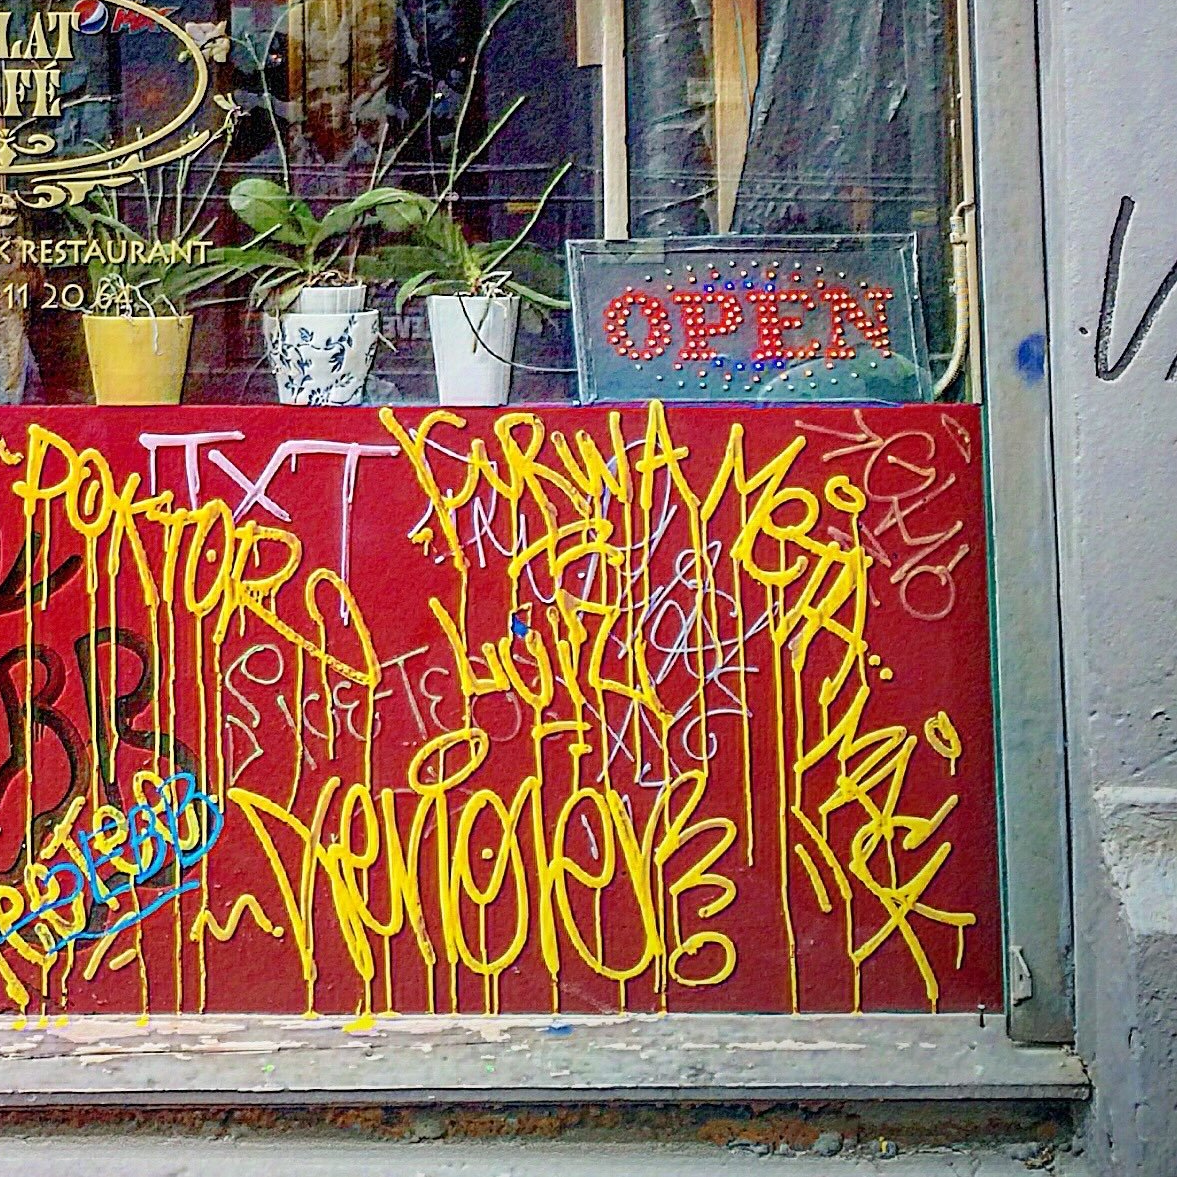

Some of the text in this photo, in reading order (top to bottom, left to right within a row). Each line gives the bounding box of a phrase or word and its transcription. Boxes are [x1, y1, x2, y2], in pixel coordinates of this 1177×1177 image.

[22, 239, 214, 266] RESTAURANT
[1, 281, 30, 310] 11
[40, 281, 86, 310] 20
[603, 290, 894, 360] OPEN
